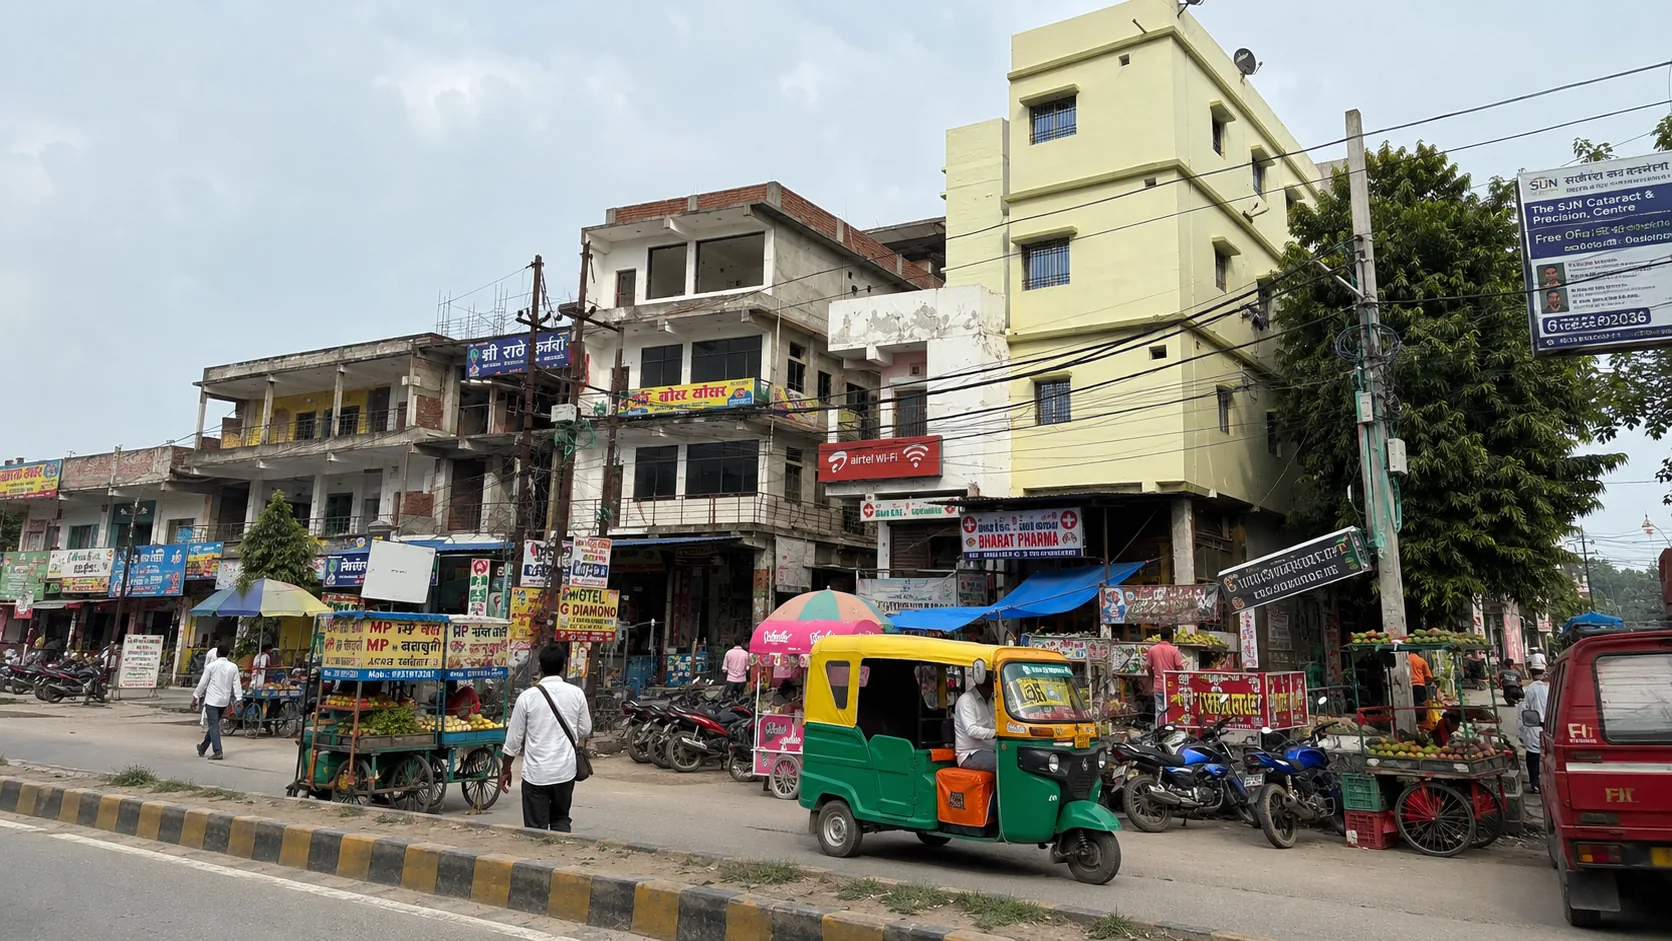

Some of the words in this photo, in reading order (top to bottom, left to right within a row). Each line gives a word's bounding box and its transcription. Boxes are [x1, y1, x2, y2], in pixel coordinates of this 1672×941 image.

[1529, 177, 1558, 191] SUN
[1531, 205, 1554, 215] The
[1586, 192, 1642, 208] Cataract
[1644, 190, 1655, 199] &
[1593, 204, 1636, 217] Centre
[1535, 234, 1562, 244] Free
[850, 454, 874, 465] airtel
[875, 452, 898, 463] Wi-Fi
[978, 533, 1015, 549] BHARAT
[1017, 531, 1059, 548] PHARMA
[560, 602, 570, 615] G
[369, 620, 392, 634] MP
[366, 638, 390, 652] MP
